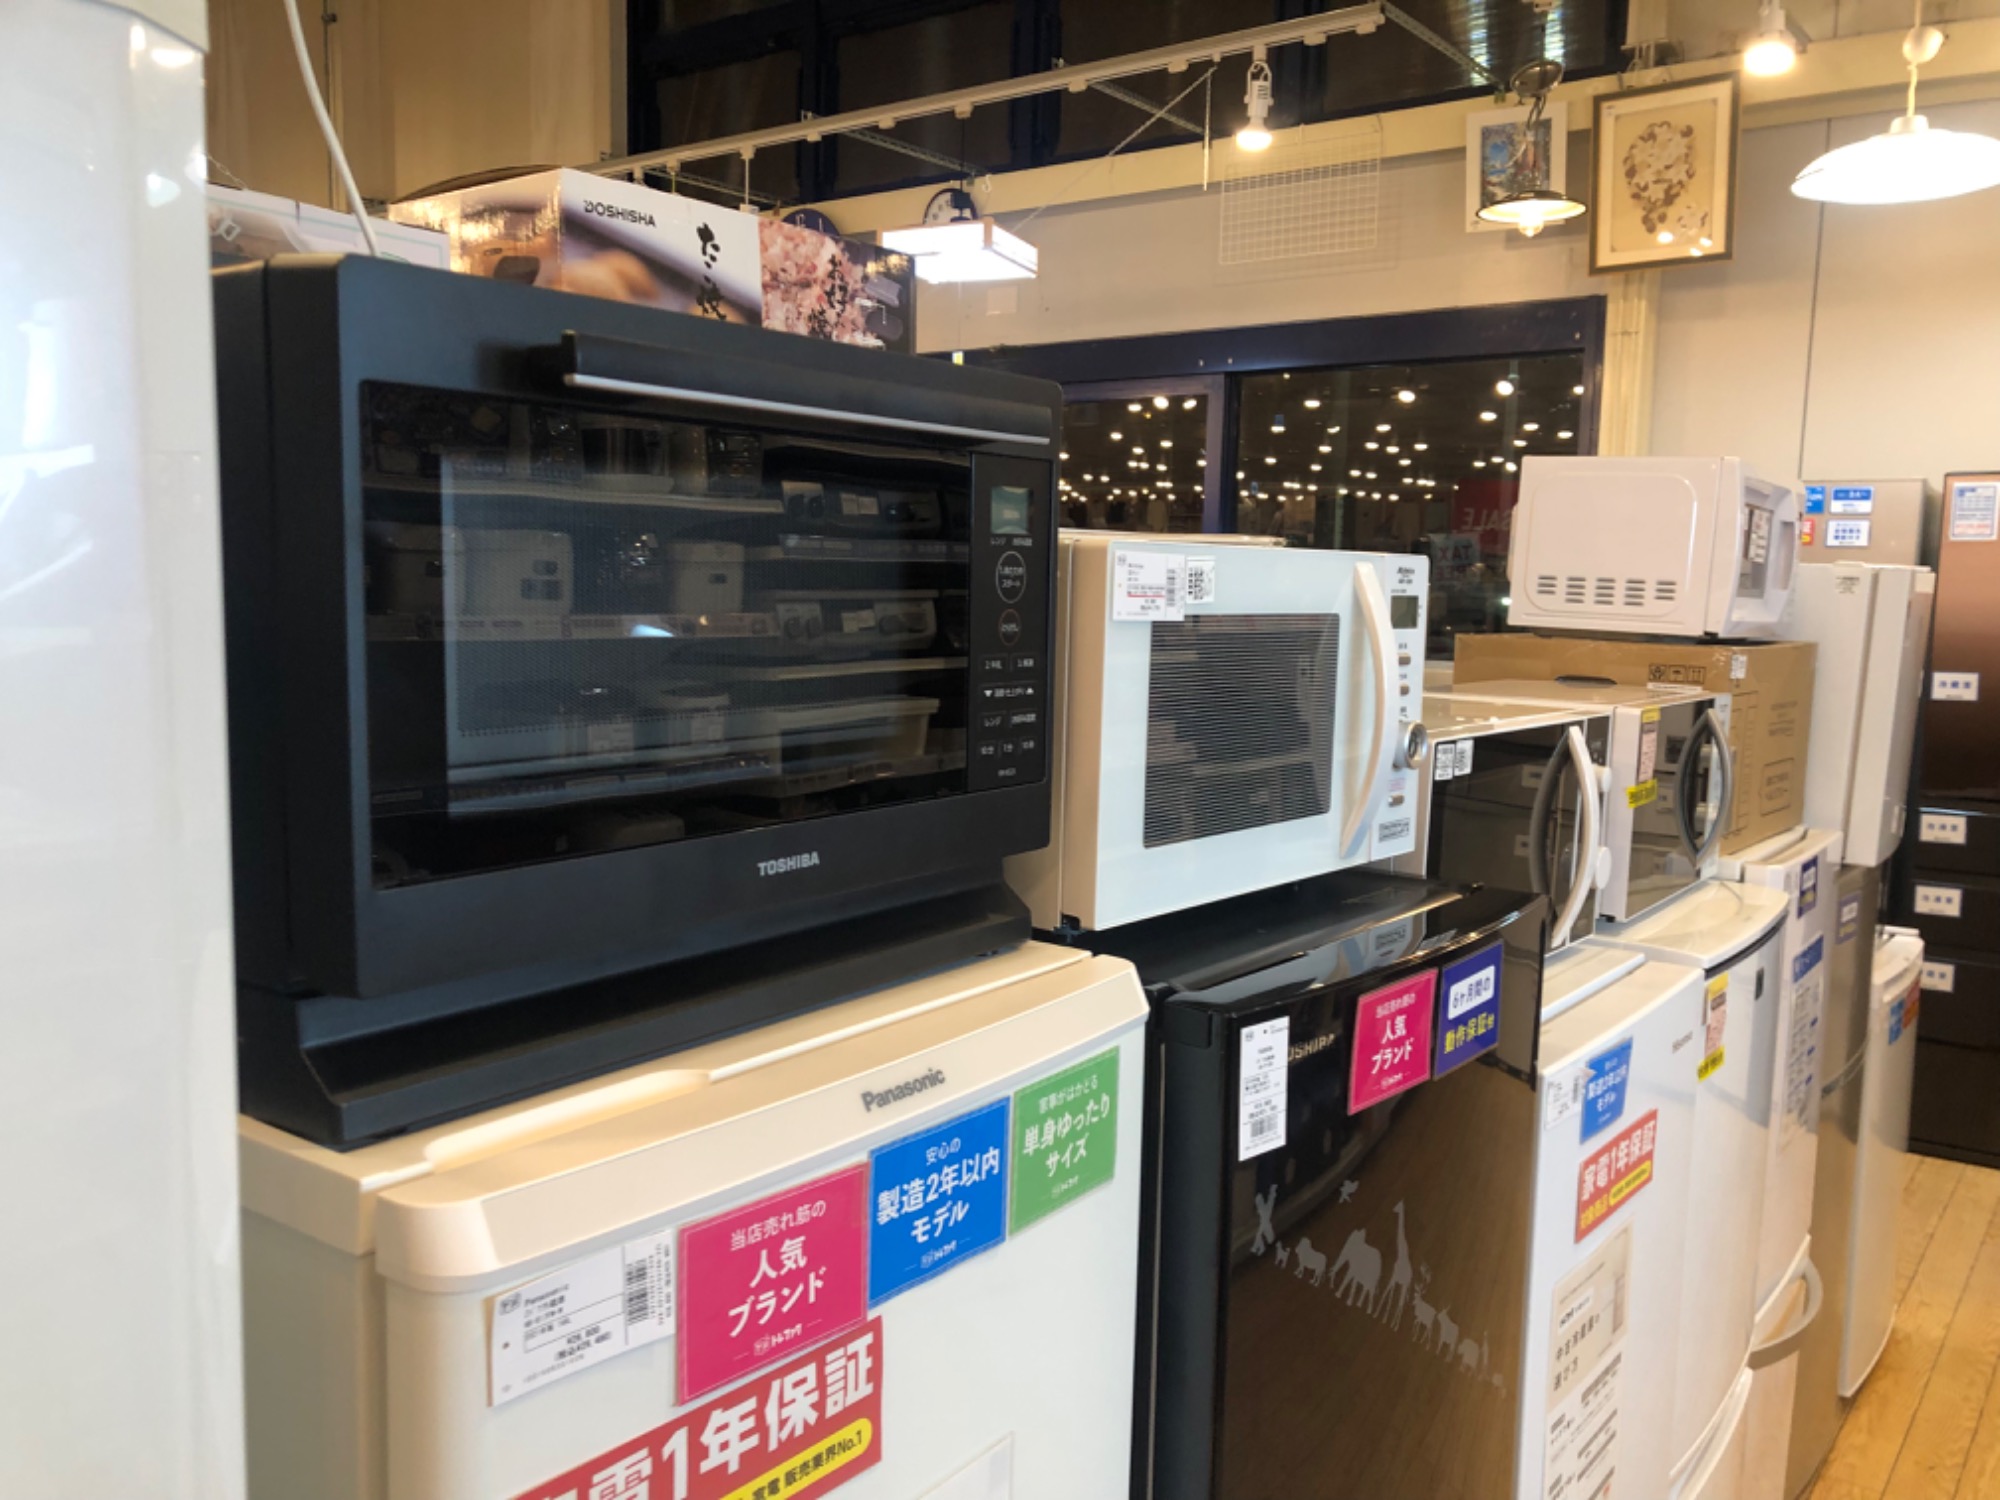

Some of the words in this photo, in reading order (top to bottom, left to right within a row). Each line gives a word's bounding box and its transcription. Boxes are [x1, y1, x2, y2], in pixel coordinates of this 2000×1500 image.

[583, 200, 657, 228] DOSHISHA
[757, 851, 820, 877] TOSHIBA
[1381, 1015, 1407, 1044] 人気
[1371, 1037, 1415, 1075] ブランド
[861, 1067, 946, 1113] Panasonic
[1023, 1093, 1111, 1156] 単身ゆったり
[926, 1137, 961, 1166] 安心の
[1045, 1133, 1090, 1178] サイズ
[877, 1146, 1000, 1226] 製造2年以内
[730, 1199, 826, 1252] 当店売れ筋の
[911, 1200, 969, 1244] モデル
[749, 1236, 807, 1288] 人気
[728, 1266, 827, 1338] ブランド
[541, 1331, 874, 1500] 電1年保証
[784, 1430, 862, 1488] 販売業界No.1
